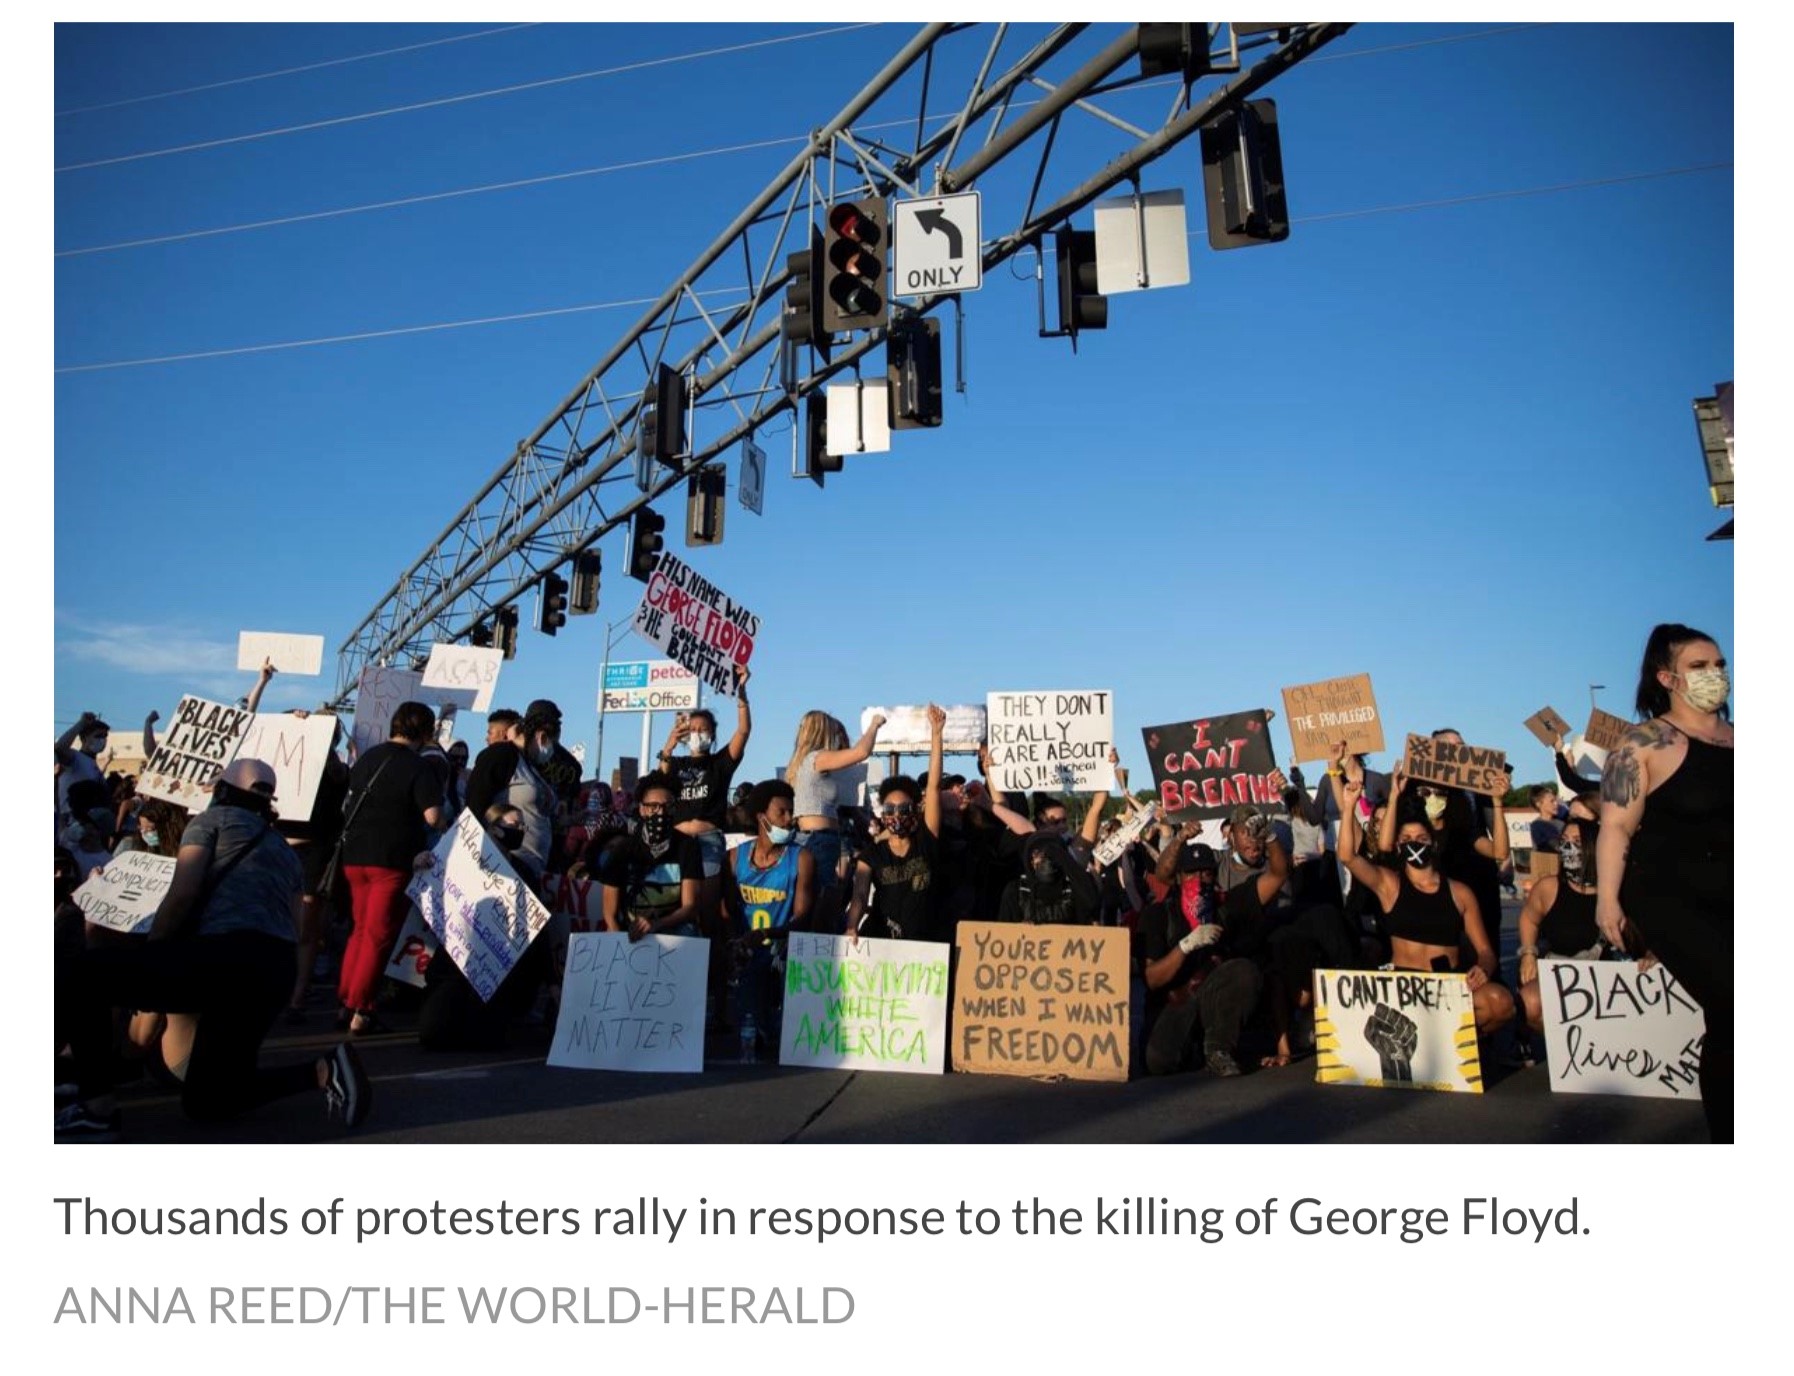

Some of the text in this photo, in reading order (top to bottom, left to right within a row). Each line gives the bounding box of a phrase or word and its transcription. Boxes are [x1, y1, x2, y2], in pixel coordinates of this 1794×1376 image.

[907, 266, 964, 289] ONLY
[658, 551, 760, 637] HIS NAME WAS
[644, 606, 664, 641] HE
[647, 571, 754, 667] GEORGE FLOYD
[649, 691, 692, 708] Office
[997, 695, 1047, 717] THEY
[180, 699, 249, 737] BLACK
[990, 721, 1071, 745] REALLY
[1293, 714, 1317, 732] THE
[166, 723, 233, 760] LIVES
[1192, 721, 1212, 749] I
[989, 741, 1109, 766] CARE ABOUT
[1409, 757, 1497, 791] NIPPLES
[128, 854, 177, 875] WHITE
[569, 937, 678, 978] BLACK
[974, 931, 1106, 963] YOU'RE MY
[974, 964, 1117, 995] OPPOSER
[1320, 974, 1328, 1006] I
[1552, 963, 1700, 1024] BLACK
[589, 980, 676, 1013] LIVES
[823, 995, 920, 1027] WHITE
[962, 998, 1129, 1026] WHEN I WANT
[566, 1014, 685, 1053] MATTER
[792, 1011, 928, 1064] AMERICA
[962, 1024, 1124, 1069] FREEDOM
[1560, 1025, 1664, 1079] lives
